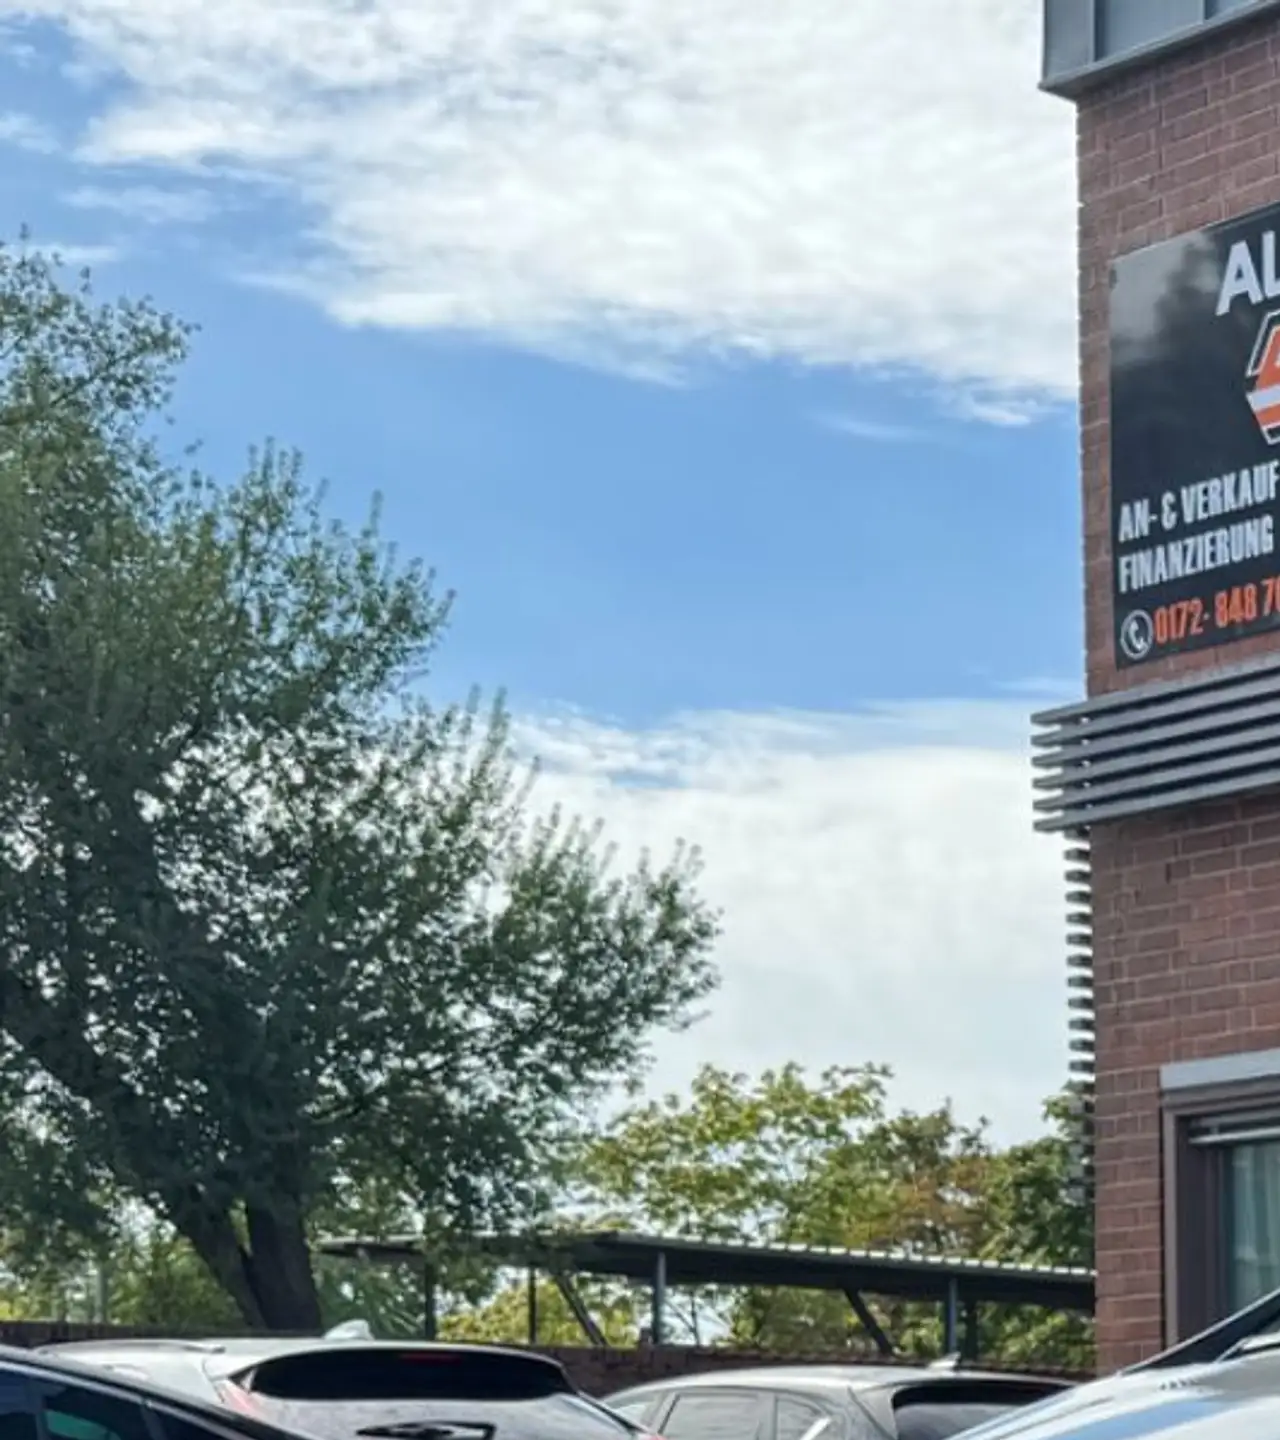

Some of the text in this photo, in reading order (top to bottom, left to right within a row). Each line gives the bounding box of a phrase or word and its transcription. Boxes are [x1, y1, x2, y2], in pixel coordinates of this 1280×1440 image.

[1118, 460, 1280, 543] AN- & VERKAUF
[1118, 514, 1275, 595] FINANZIERUNG
